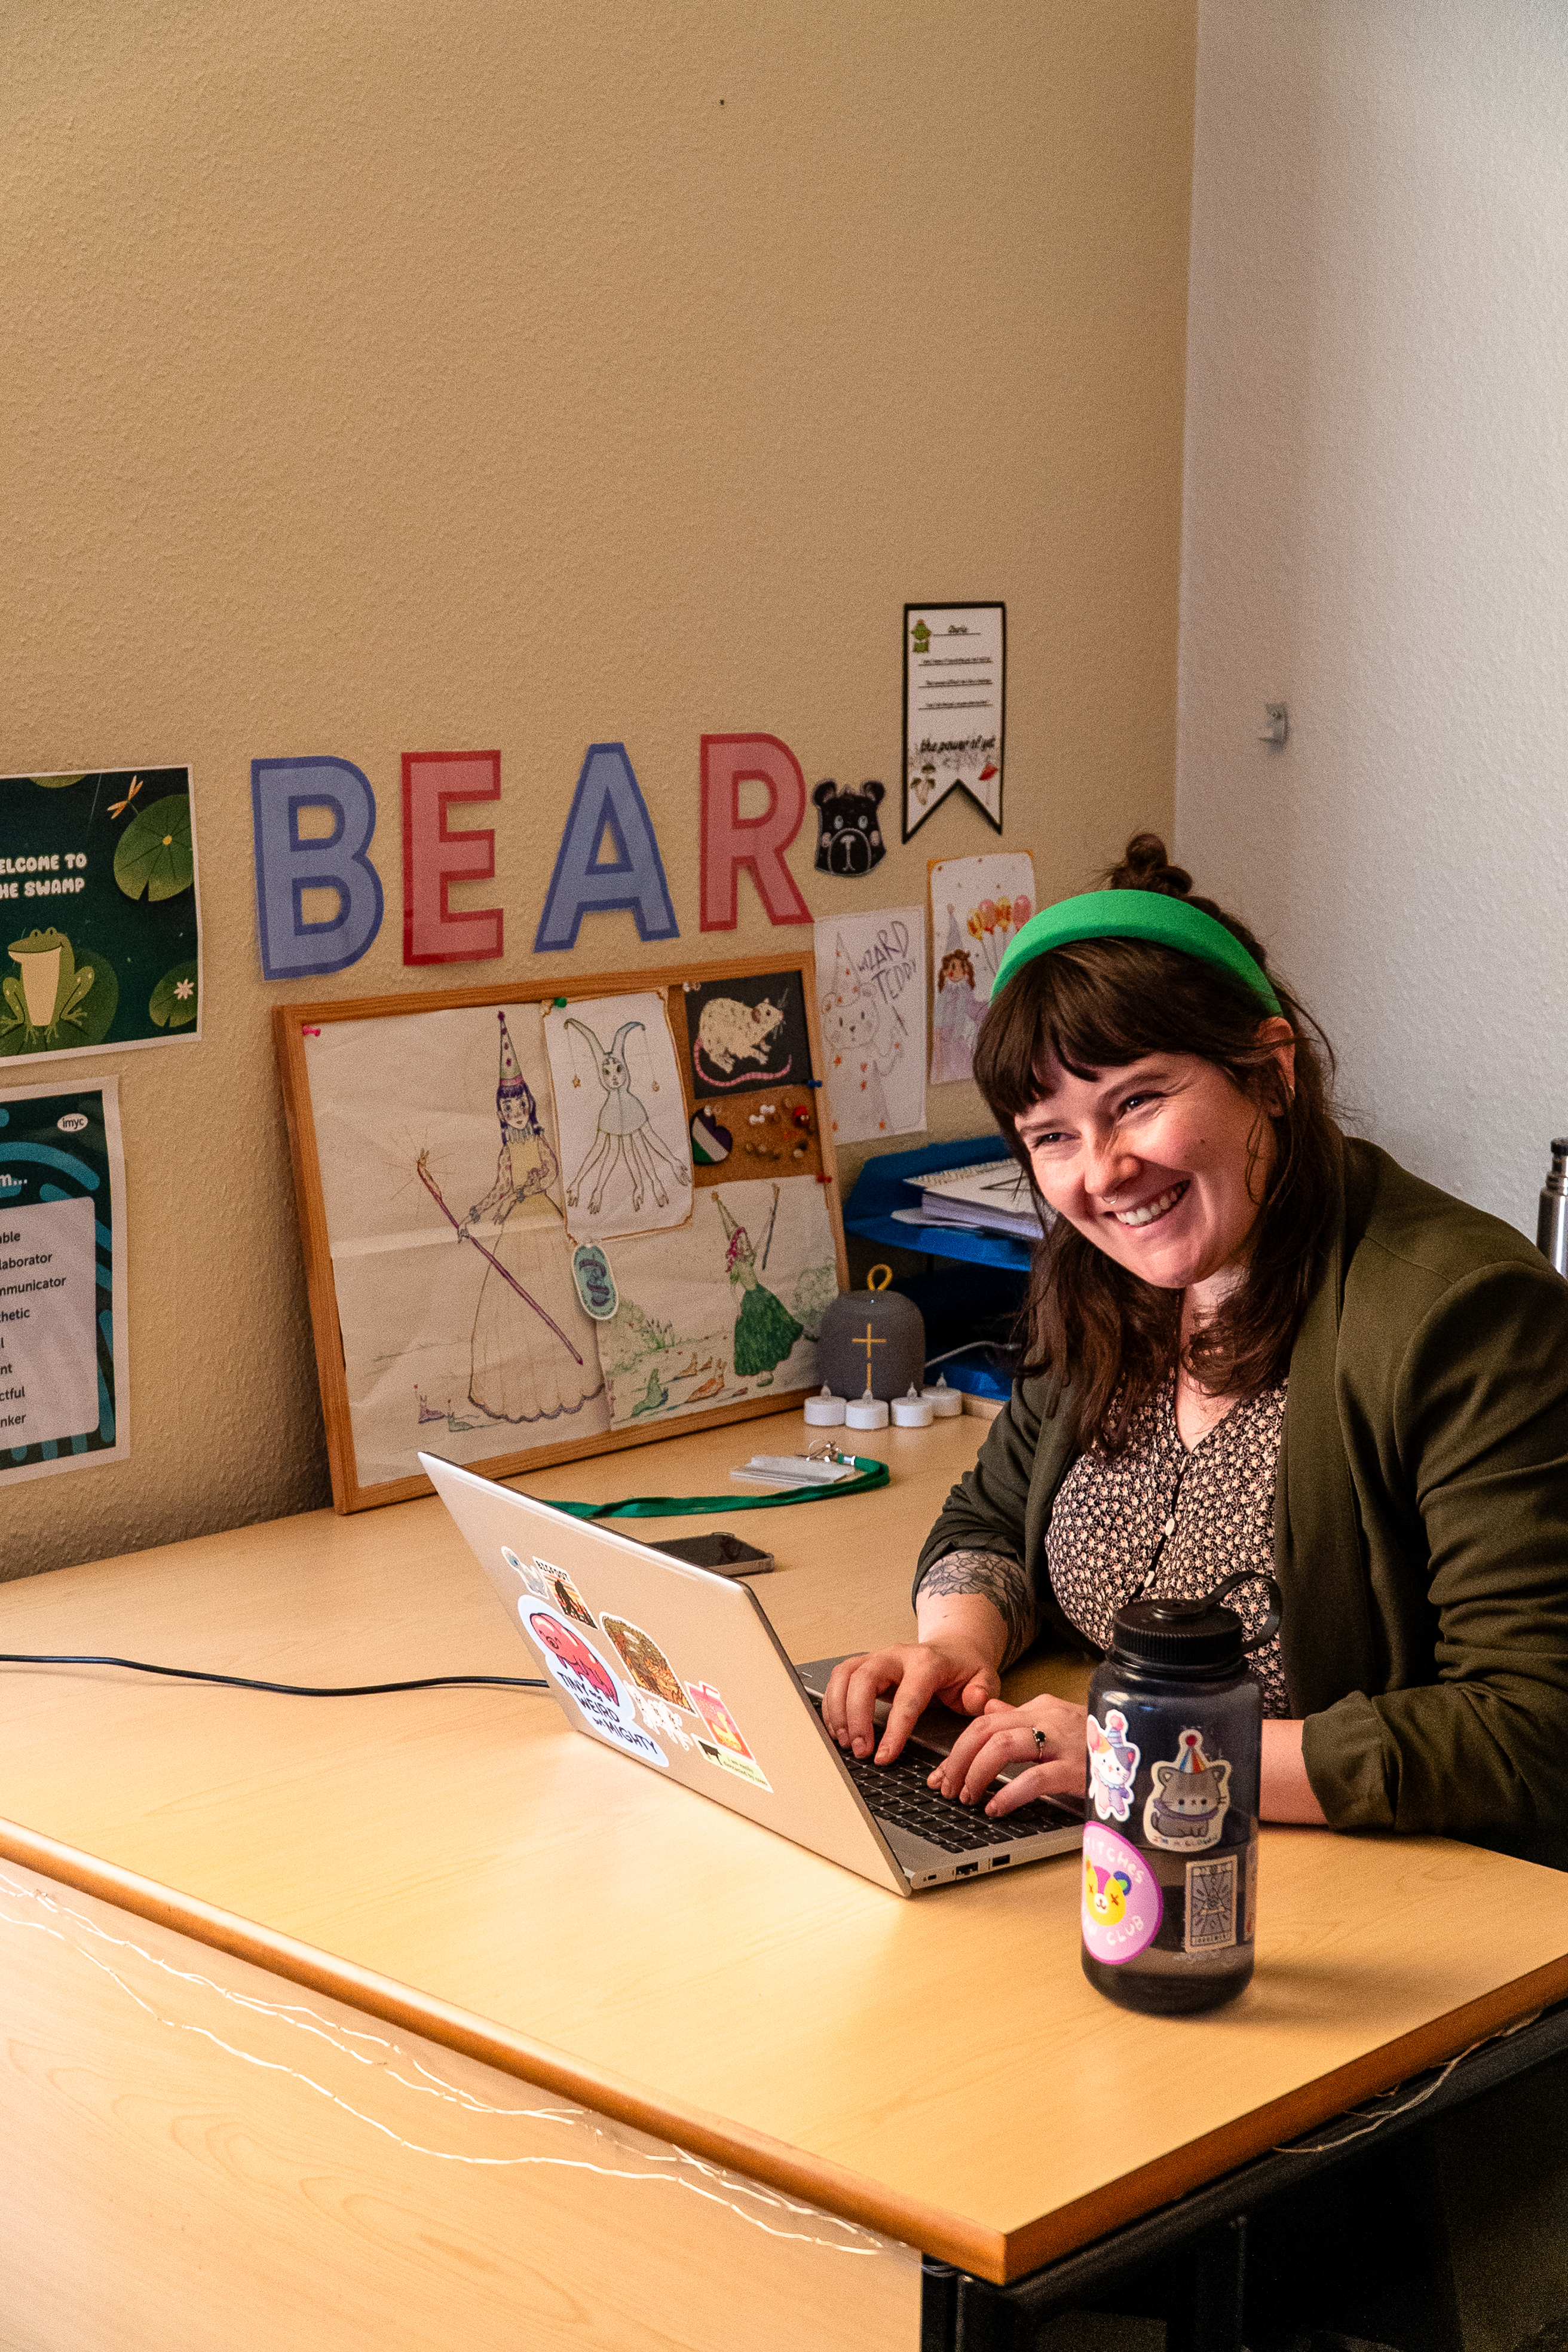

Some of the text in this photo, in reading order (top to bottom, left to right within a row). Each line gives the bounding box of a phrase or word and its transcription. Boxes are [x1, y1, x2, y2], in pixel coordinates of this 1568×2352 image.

[64, 853, 87, 869] TO
[250, 732, 814, 981] BEAR
[24, 877, 85, 897] SWAMP
[62, 1117, 84, 1129] imyc
[0, 1307, 30, 1322] hetic
[557, 1671, 589, 1696] TINY
[574, 1693, 620, 1722] WEIRD
[602, 1719, 657, 1754] MIGHTY
[1106, 1915, 1144, 1946] CLUB
